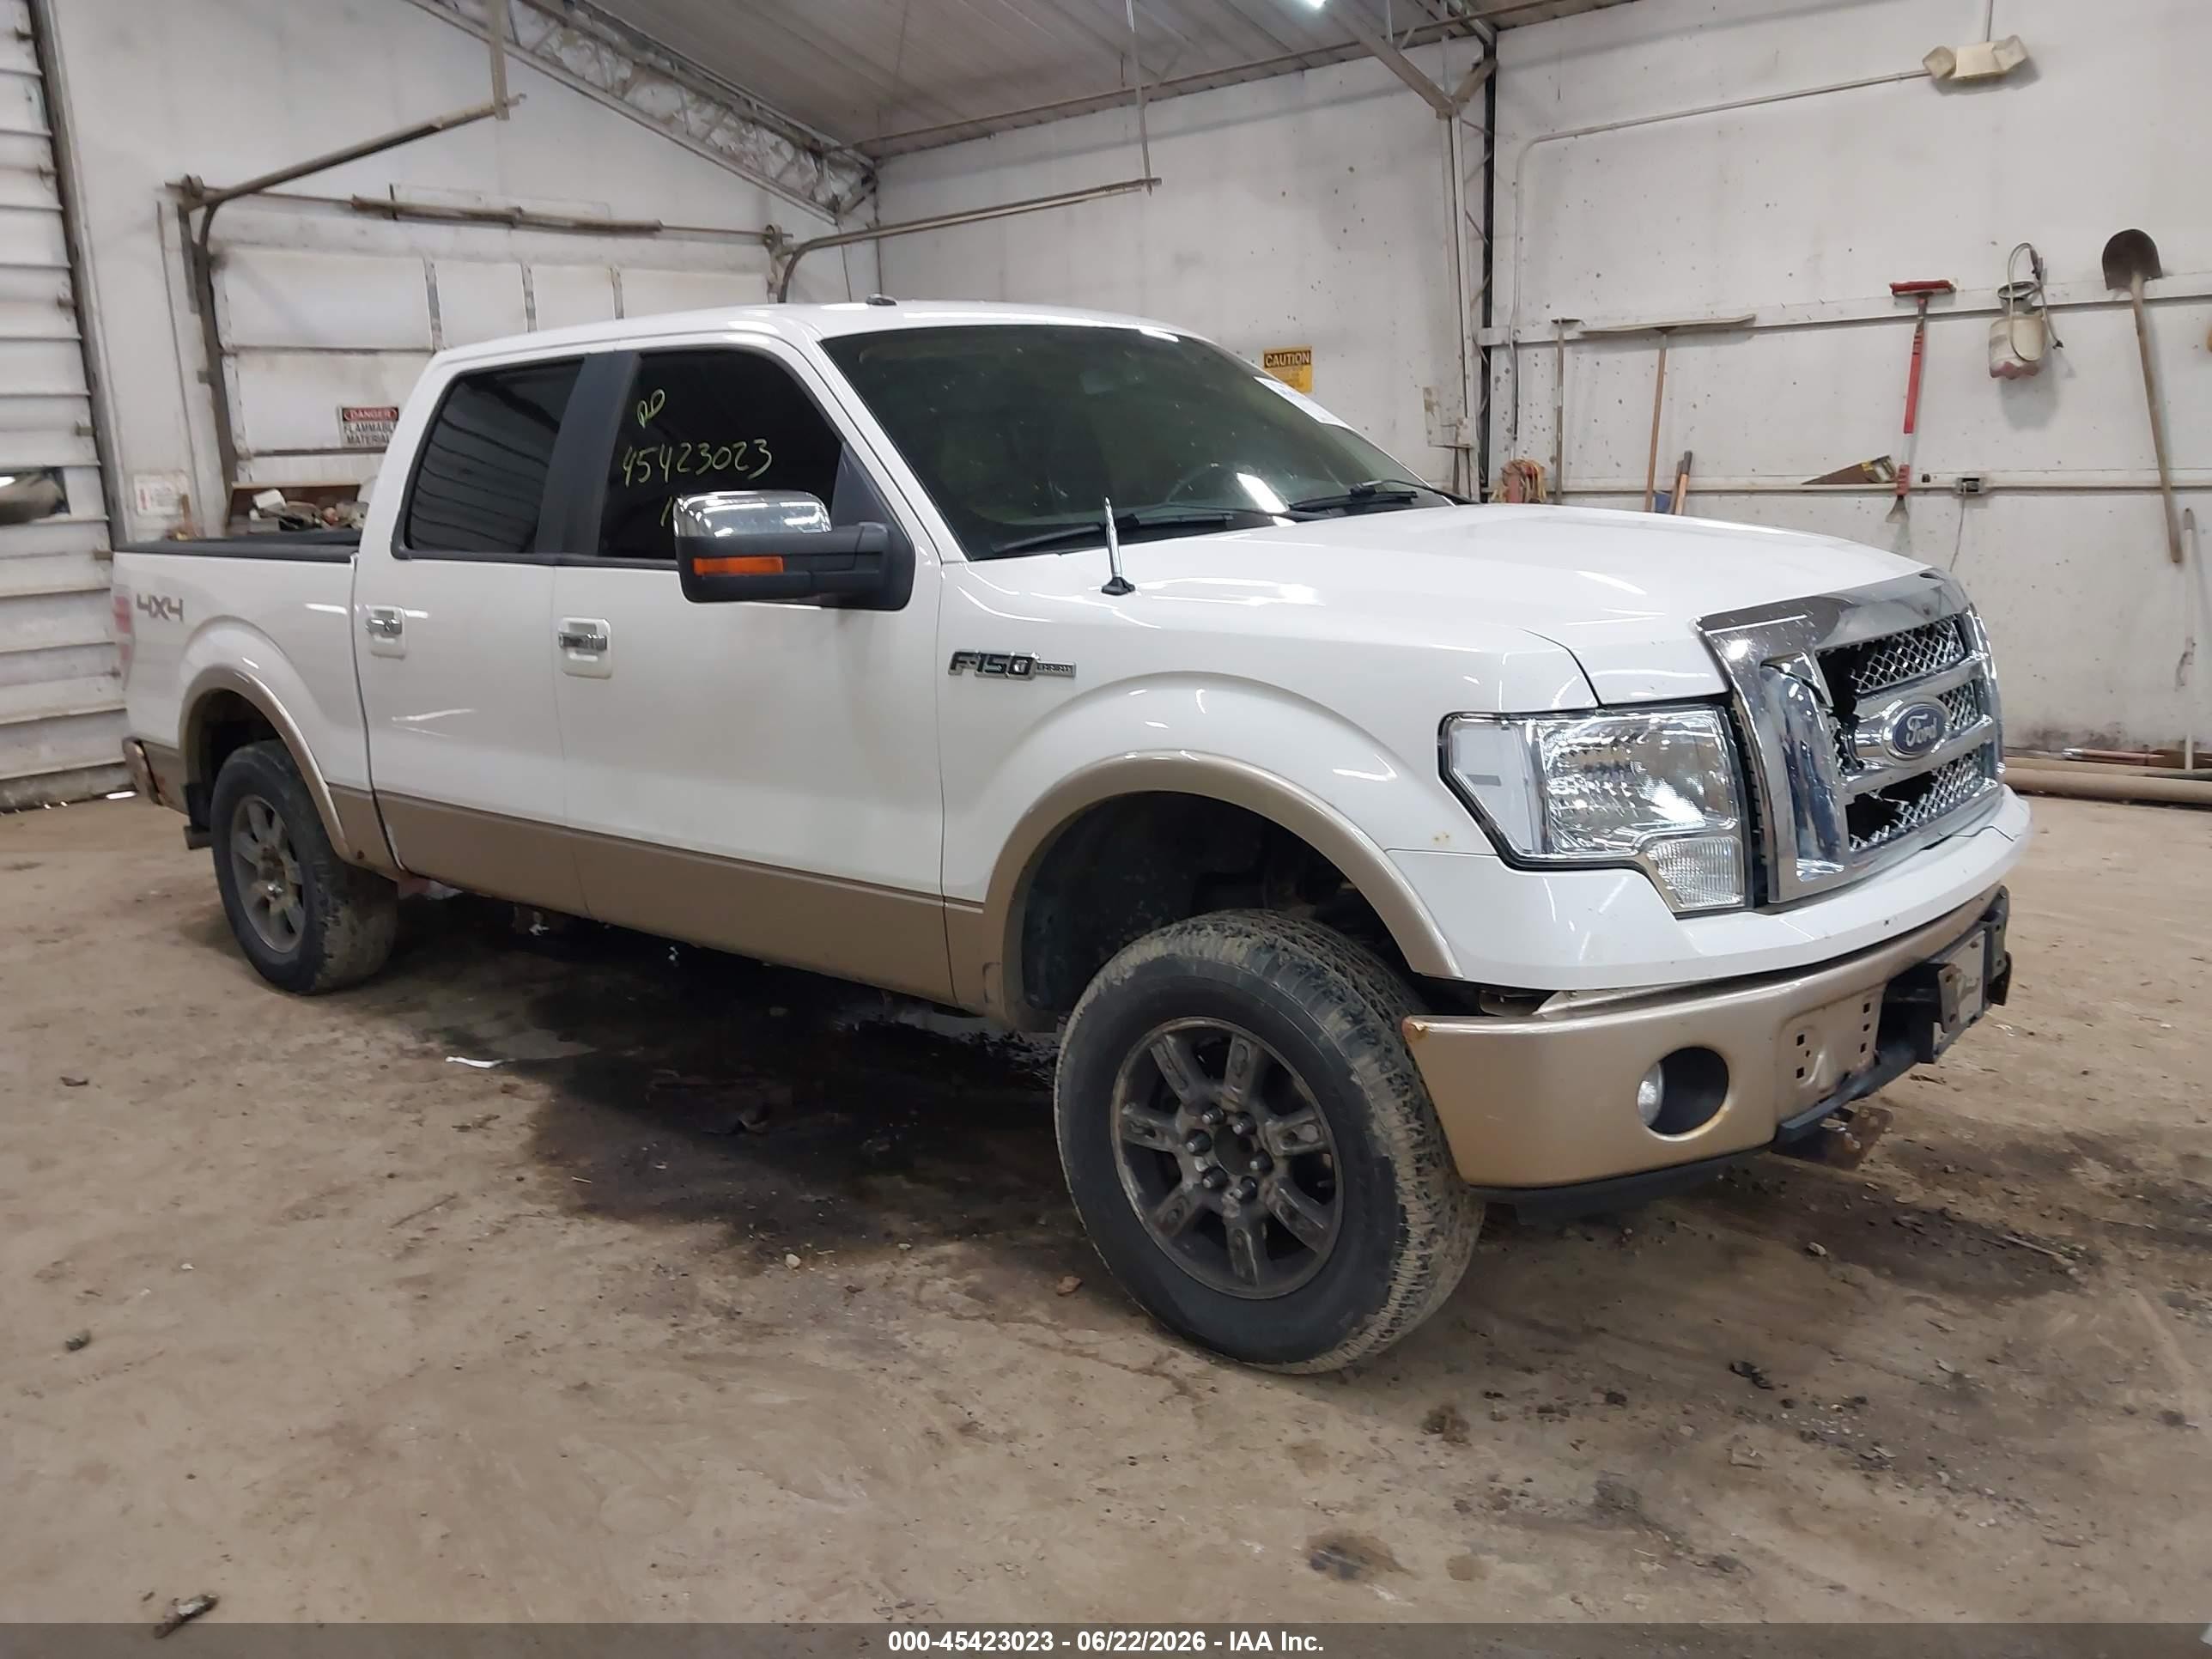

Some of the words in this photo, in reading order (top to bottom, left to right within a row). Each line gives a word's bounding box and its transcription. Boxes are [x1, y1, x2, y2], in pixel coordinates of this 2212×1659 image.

[1265, 352, 1310, 368] CAUTION
[349, 409, 392, 419] DANGER
[344, 422, 396, 433] FLAMMABL
[623, 439, 773, 488] 45423023
[1905, 713, 1937, 747] Ford
